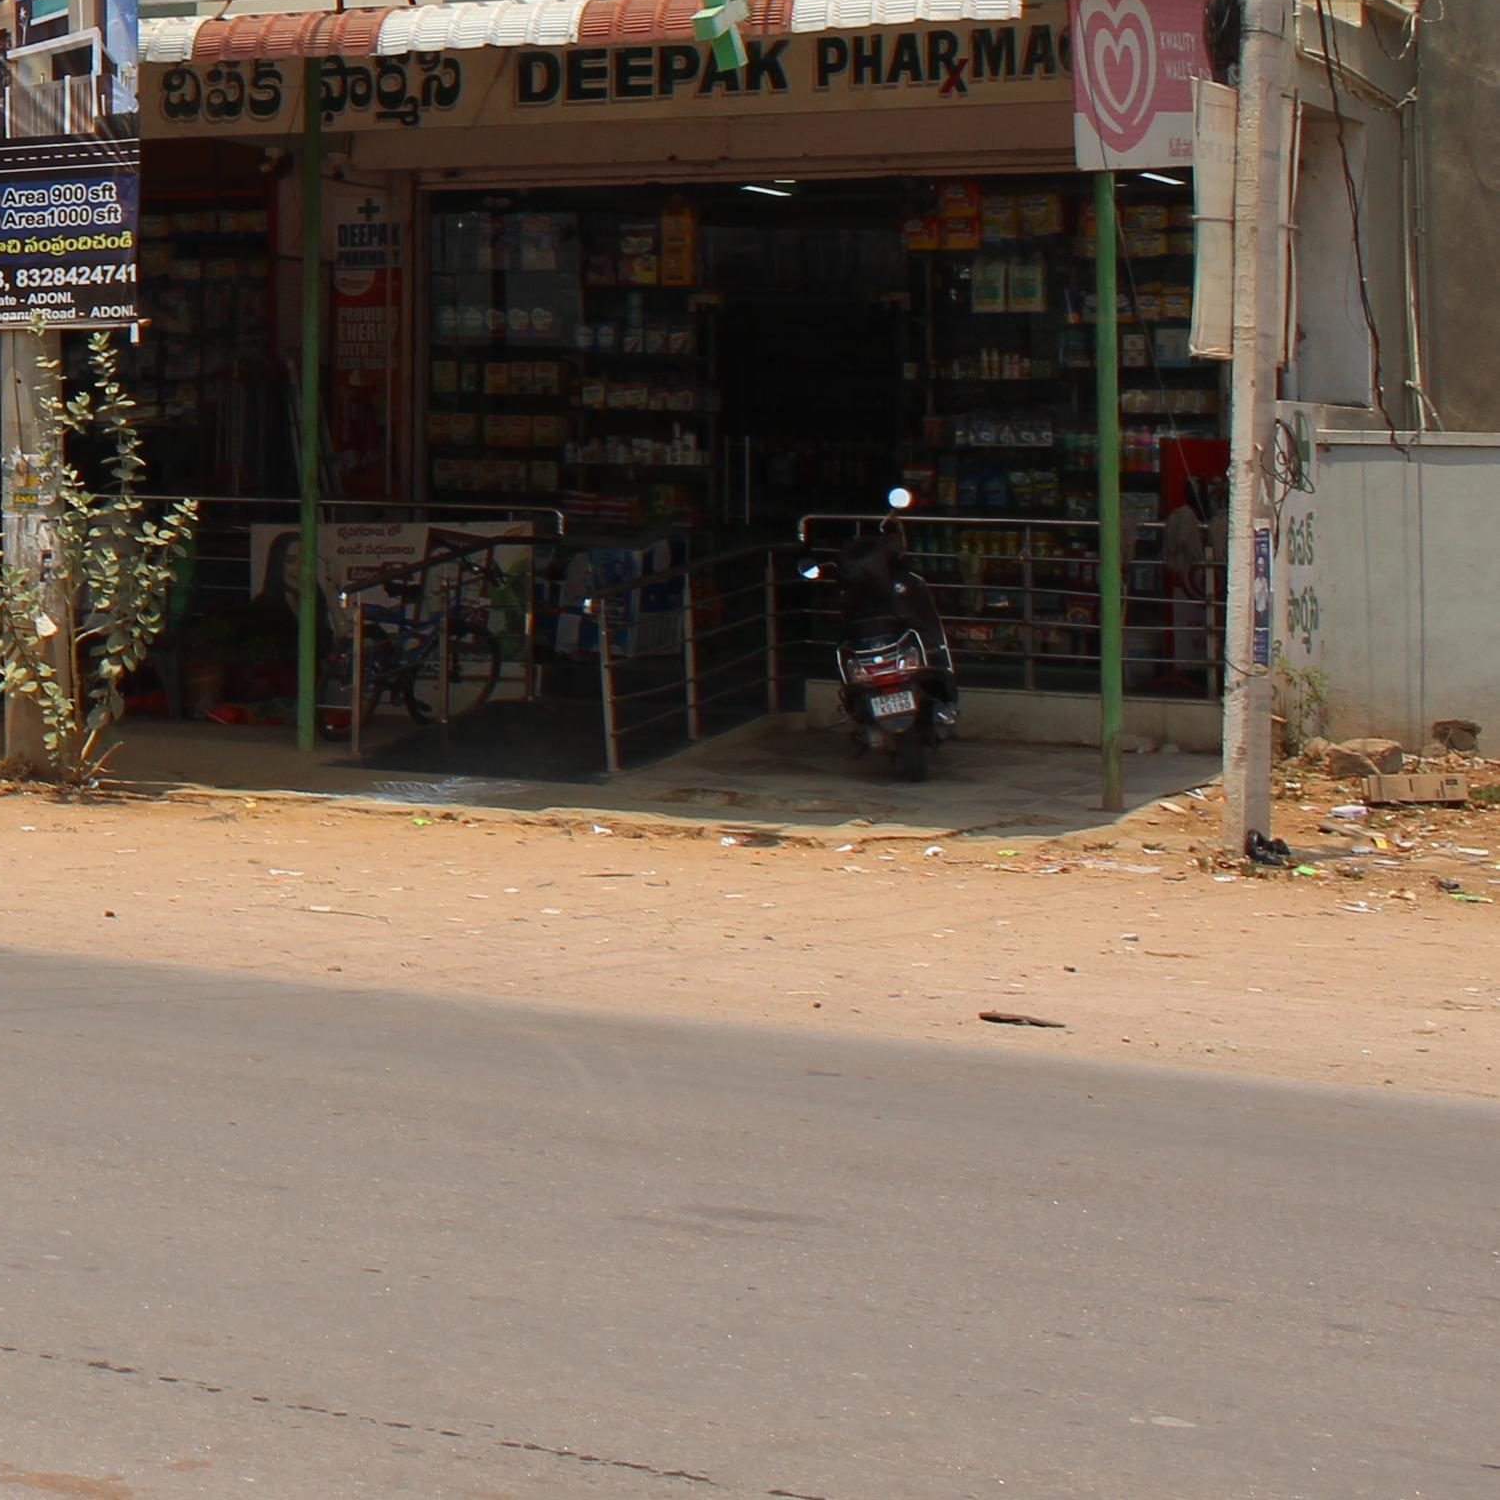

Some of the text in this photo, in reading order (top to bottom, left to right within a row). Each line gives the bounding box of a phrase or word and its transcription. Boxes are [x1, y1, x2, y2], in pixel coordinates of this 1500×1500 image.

[1159, 30, 1197, 52] KWALITY
[515, 38, 790, 105] DEEPAK
[2, 188, 46, 207] Area
[51, 185, 85, 203] 900
[88, 182, 116, 201] sft
[93, 204, 121, 224] sft
[337, 223, 401, 248] DEEPAK
[336, 250, 401, 267] PHARMAY
[15, 263, 137, 287] 8328424741
[43, 308, 75, 320] Road
[338, 323, 398, 341] ENERGY
